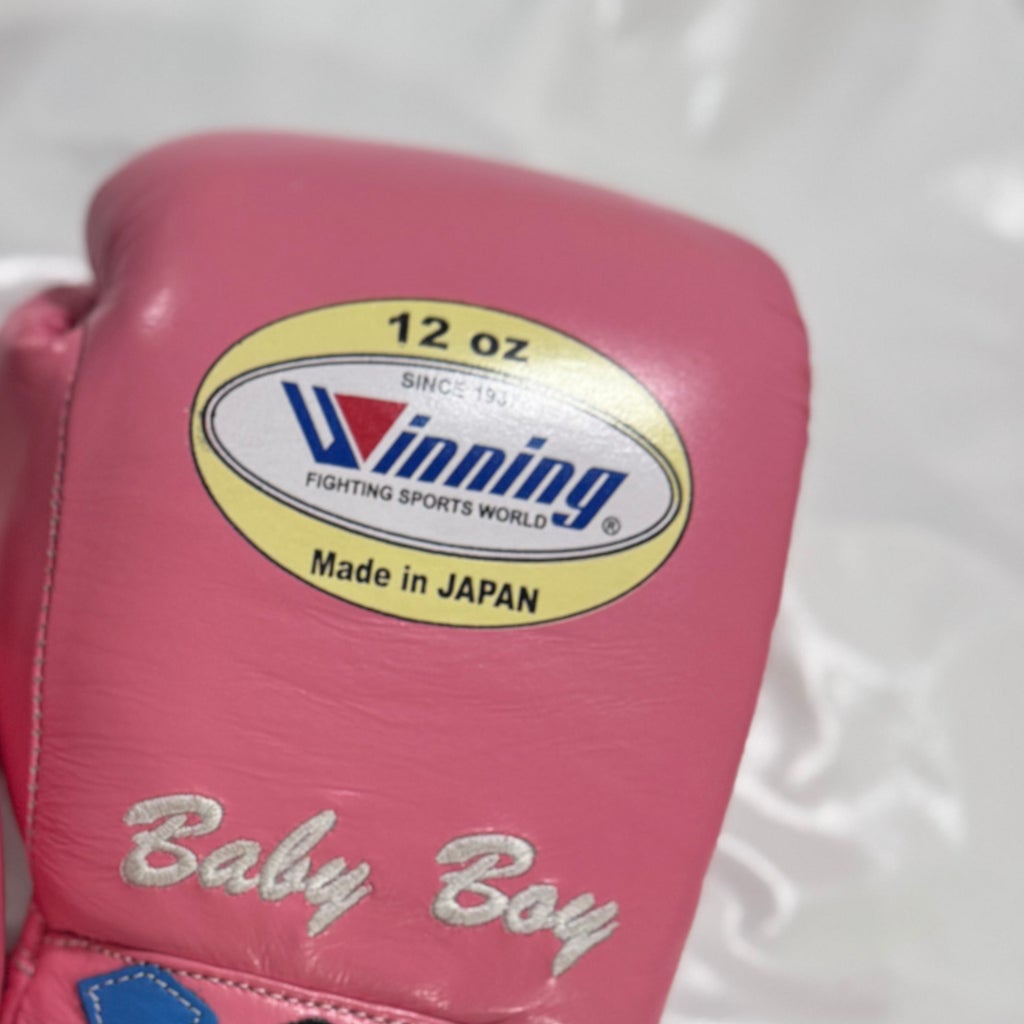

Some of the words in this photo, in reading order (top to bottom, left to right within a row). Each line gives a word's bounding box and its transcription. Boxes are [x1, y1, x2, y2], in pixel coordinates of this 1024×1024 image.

[388, 312, 450, 350] 12
[470, 331, 529, 362] oz
[280, 380, 629, 530] Winning
[305, 471, 394, 502] FIGHTING
[398, 489, 473, 517] SPORTS
[478, 503, 548, 530] WORLD
[310, 549, 392, 588] Made
[401, 565, 428, 594] in
[438, 572, 539, 613] JAPAN
[120, 793, 373, 938] Baby
[431, 832, 619, 978] Boy
